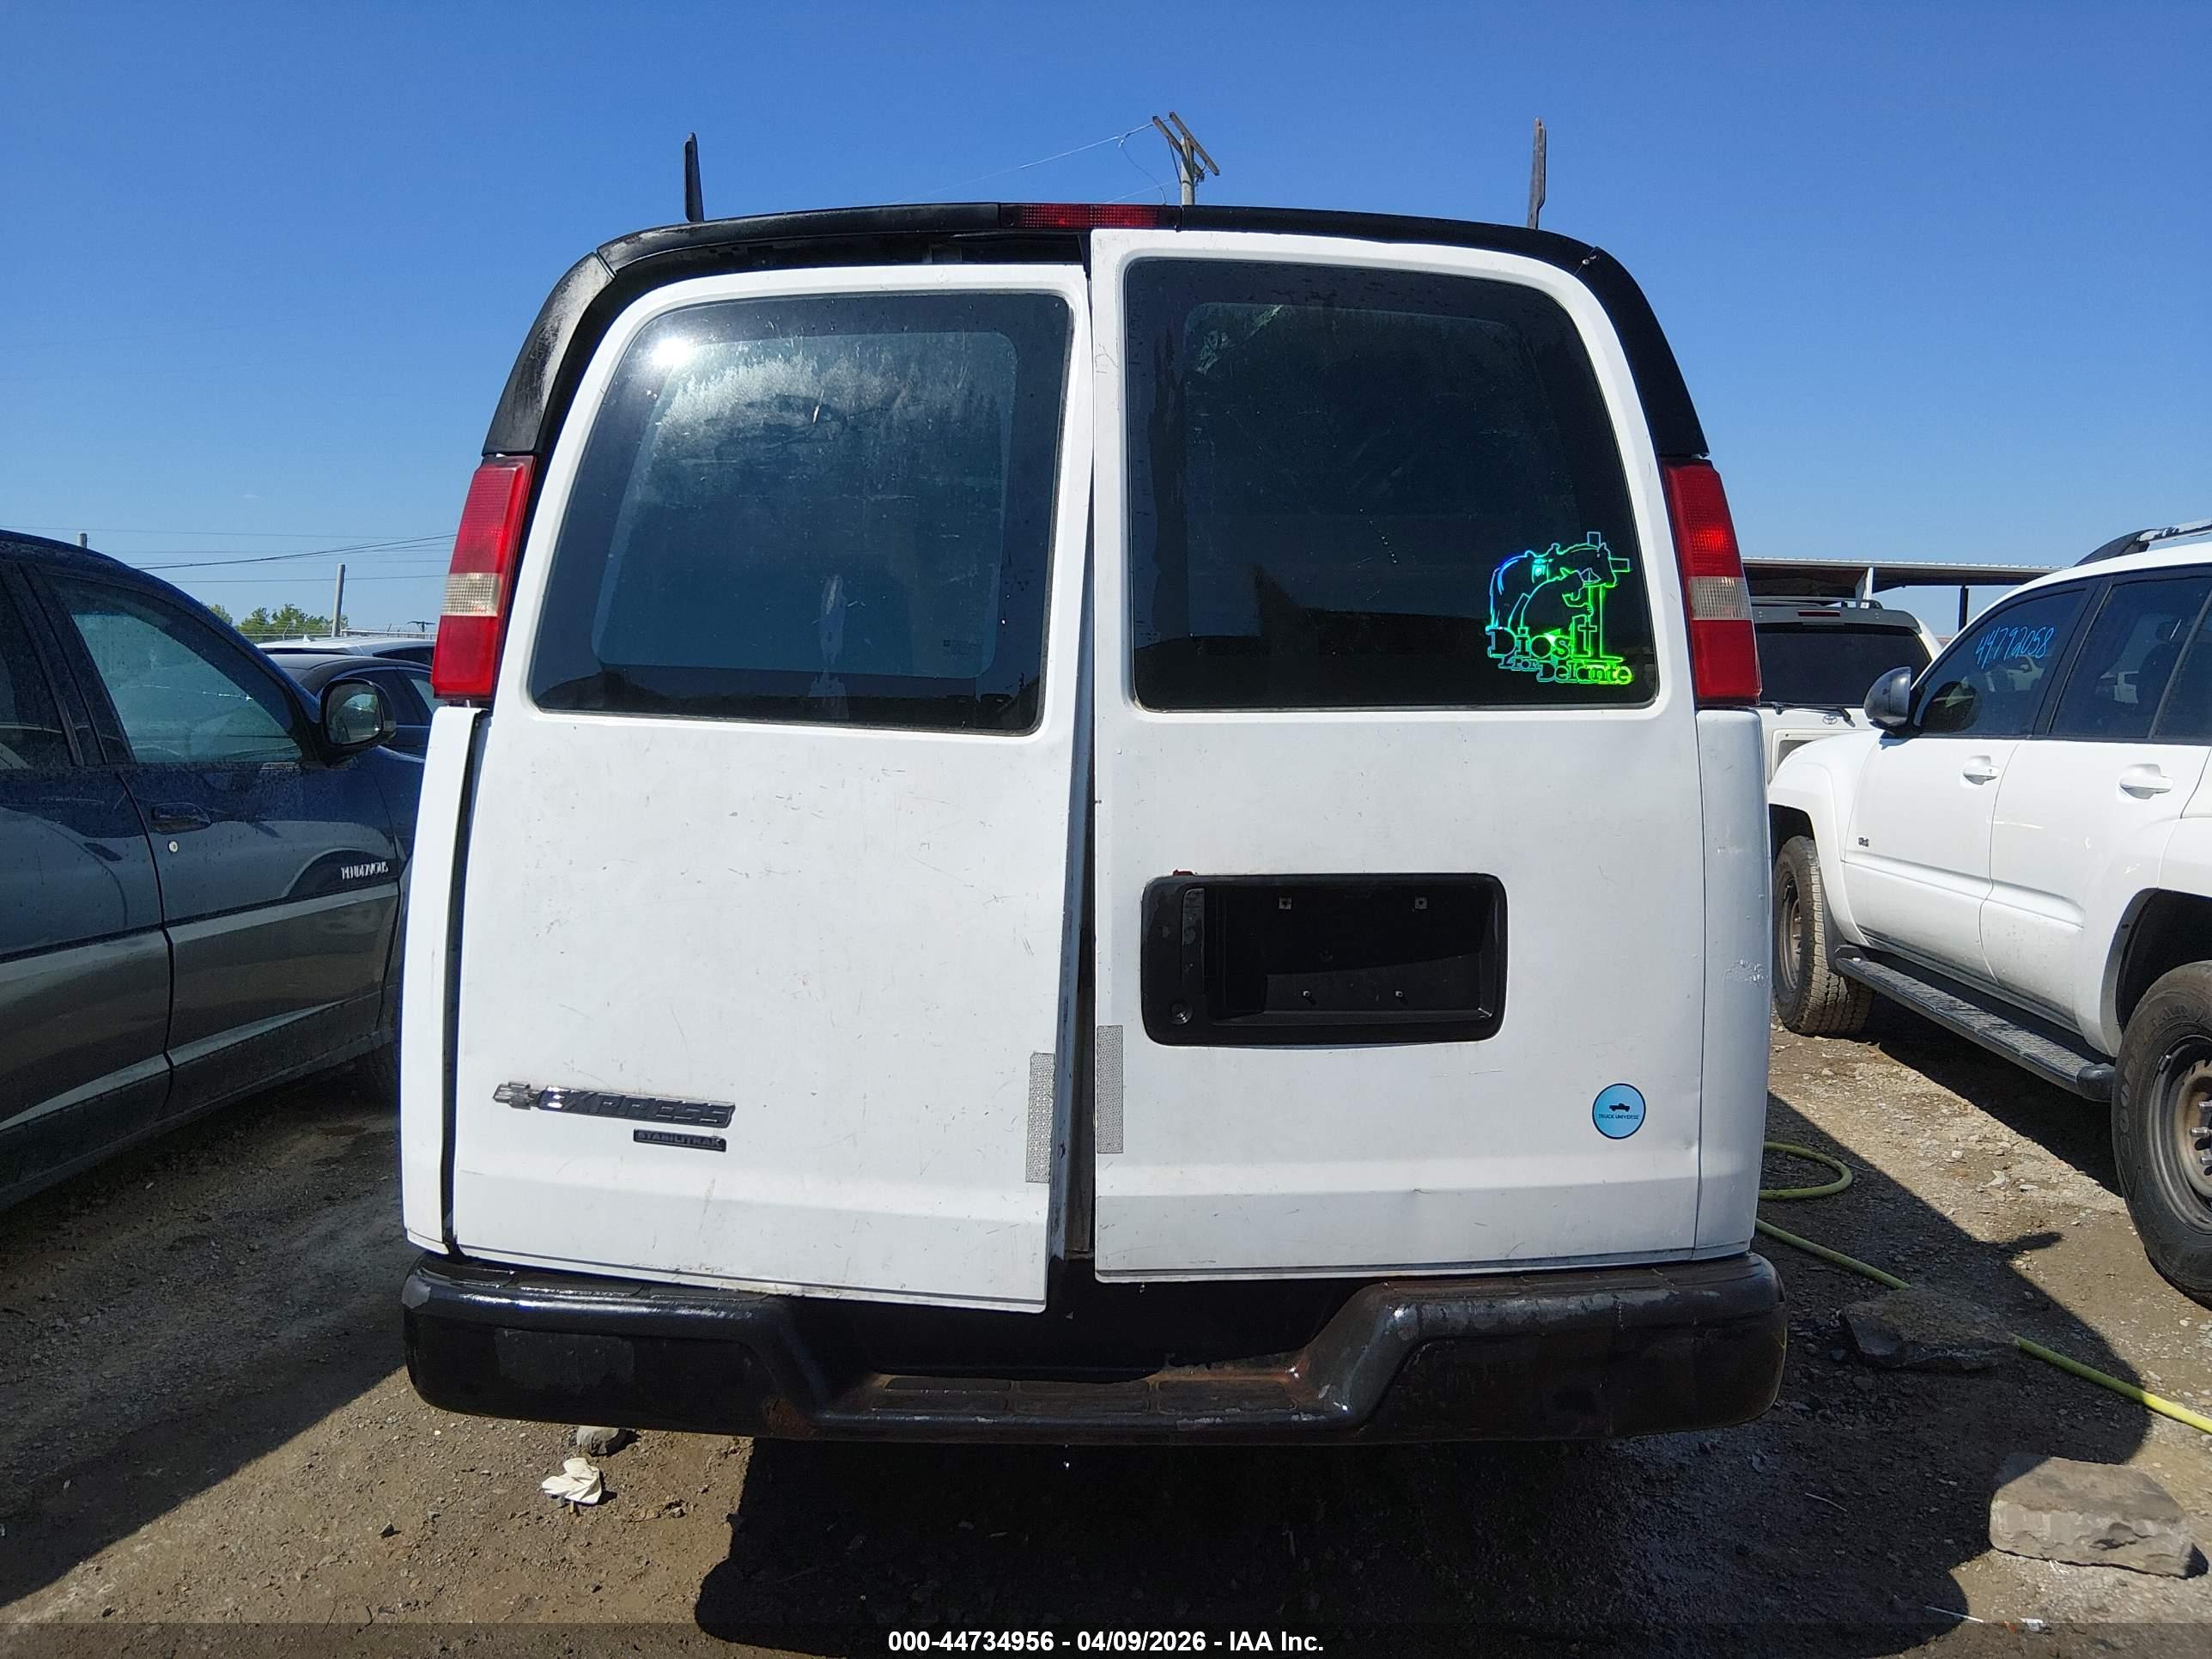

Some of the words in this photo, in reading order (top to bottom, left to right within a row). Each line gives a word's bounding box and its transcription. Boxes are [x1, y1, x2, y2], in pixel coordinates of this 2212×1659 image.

[1486, 627, 1571, 659] Dios
[1975, 626, 2055, 670] 44792058
[1539, 660, 1633, 684] Delante
[538, 1085, 736, 1128] EXPRESS
[636, 1130, 723, 1147] STABILITRAK
